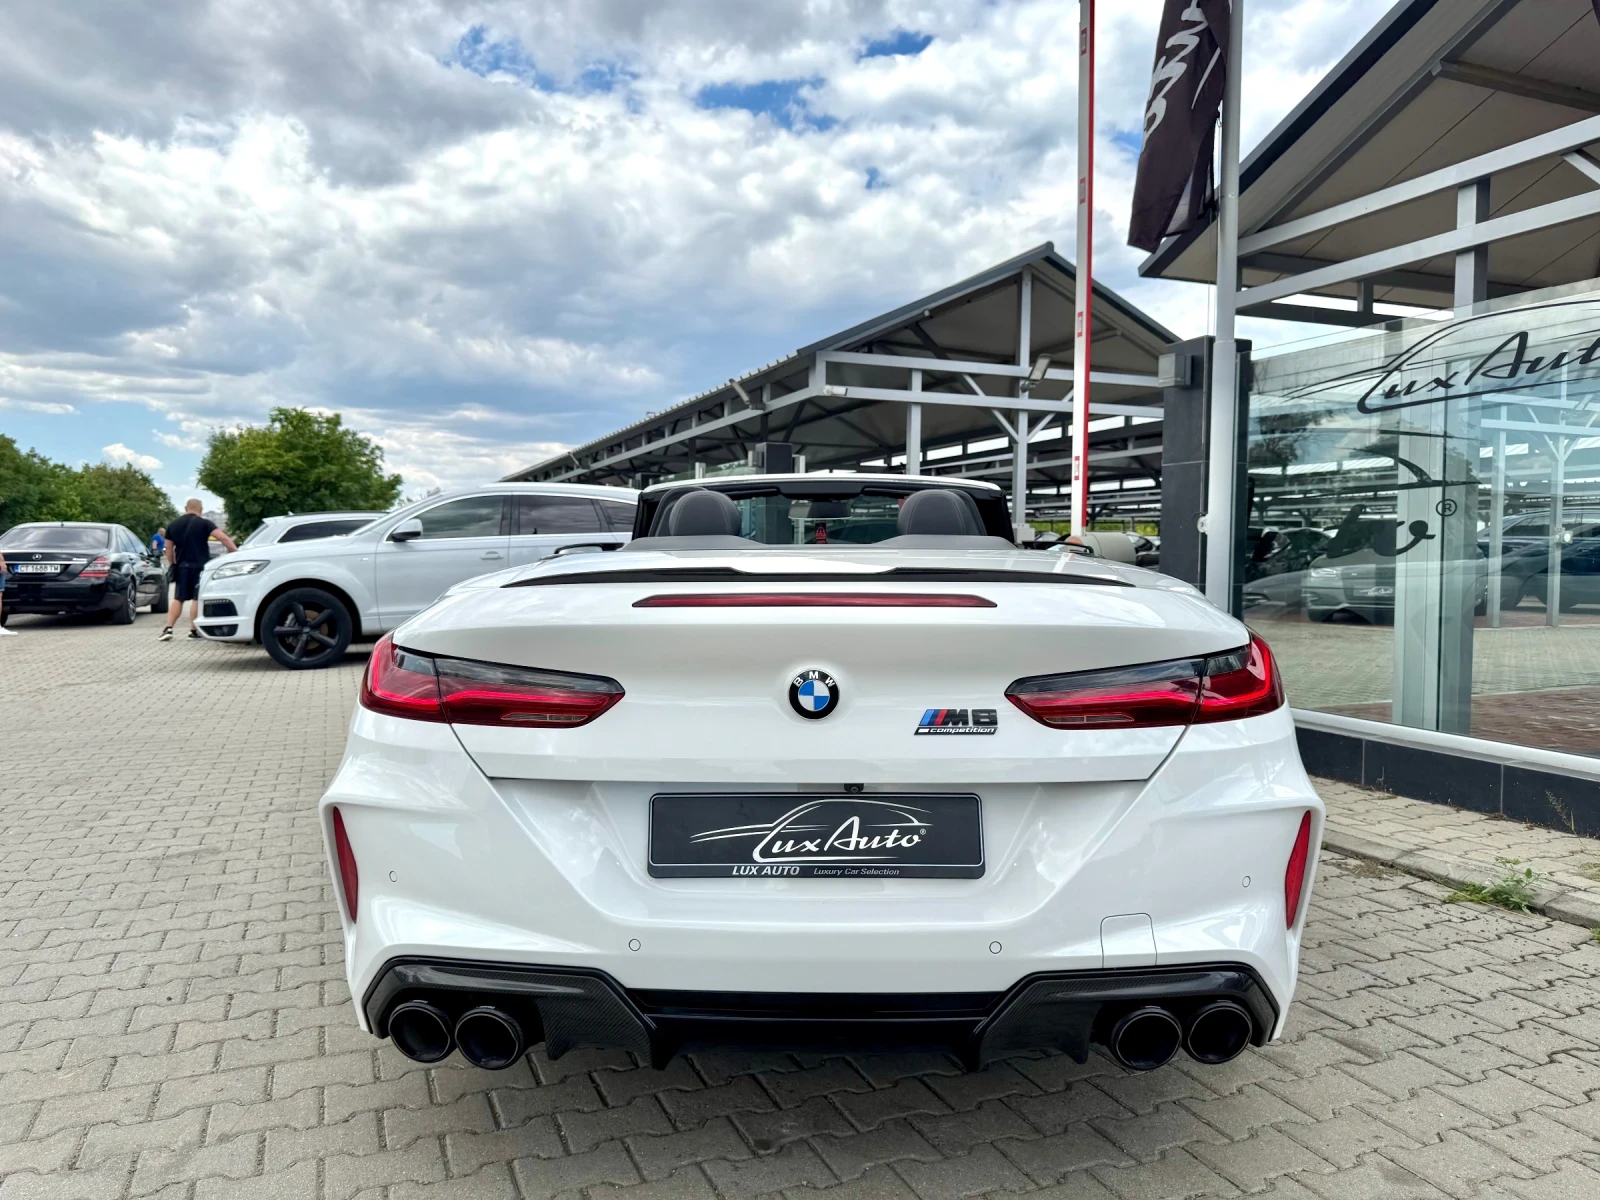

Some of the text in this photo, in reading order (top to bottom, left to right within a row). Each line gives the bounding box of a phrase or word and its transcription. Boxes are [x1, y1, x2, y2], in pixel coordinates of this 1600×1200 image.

[793, 670, 836, 688] BMW
[929, 726, 995, 734] competition
[732, 866, 800, 876] LUX AUTO
[813, 868, 842, 876] Luxury
[860, 868, 900, 876] Selection
